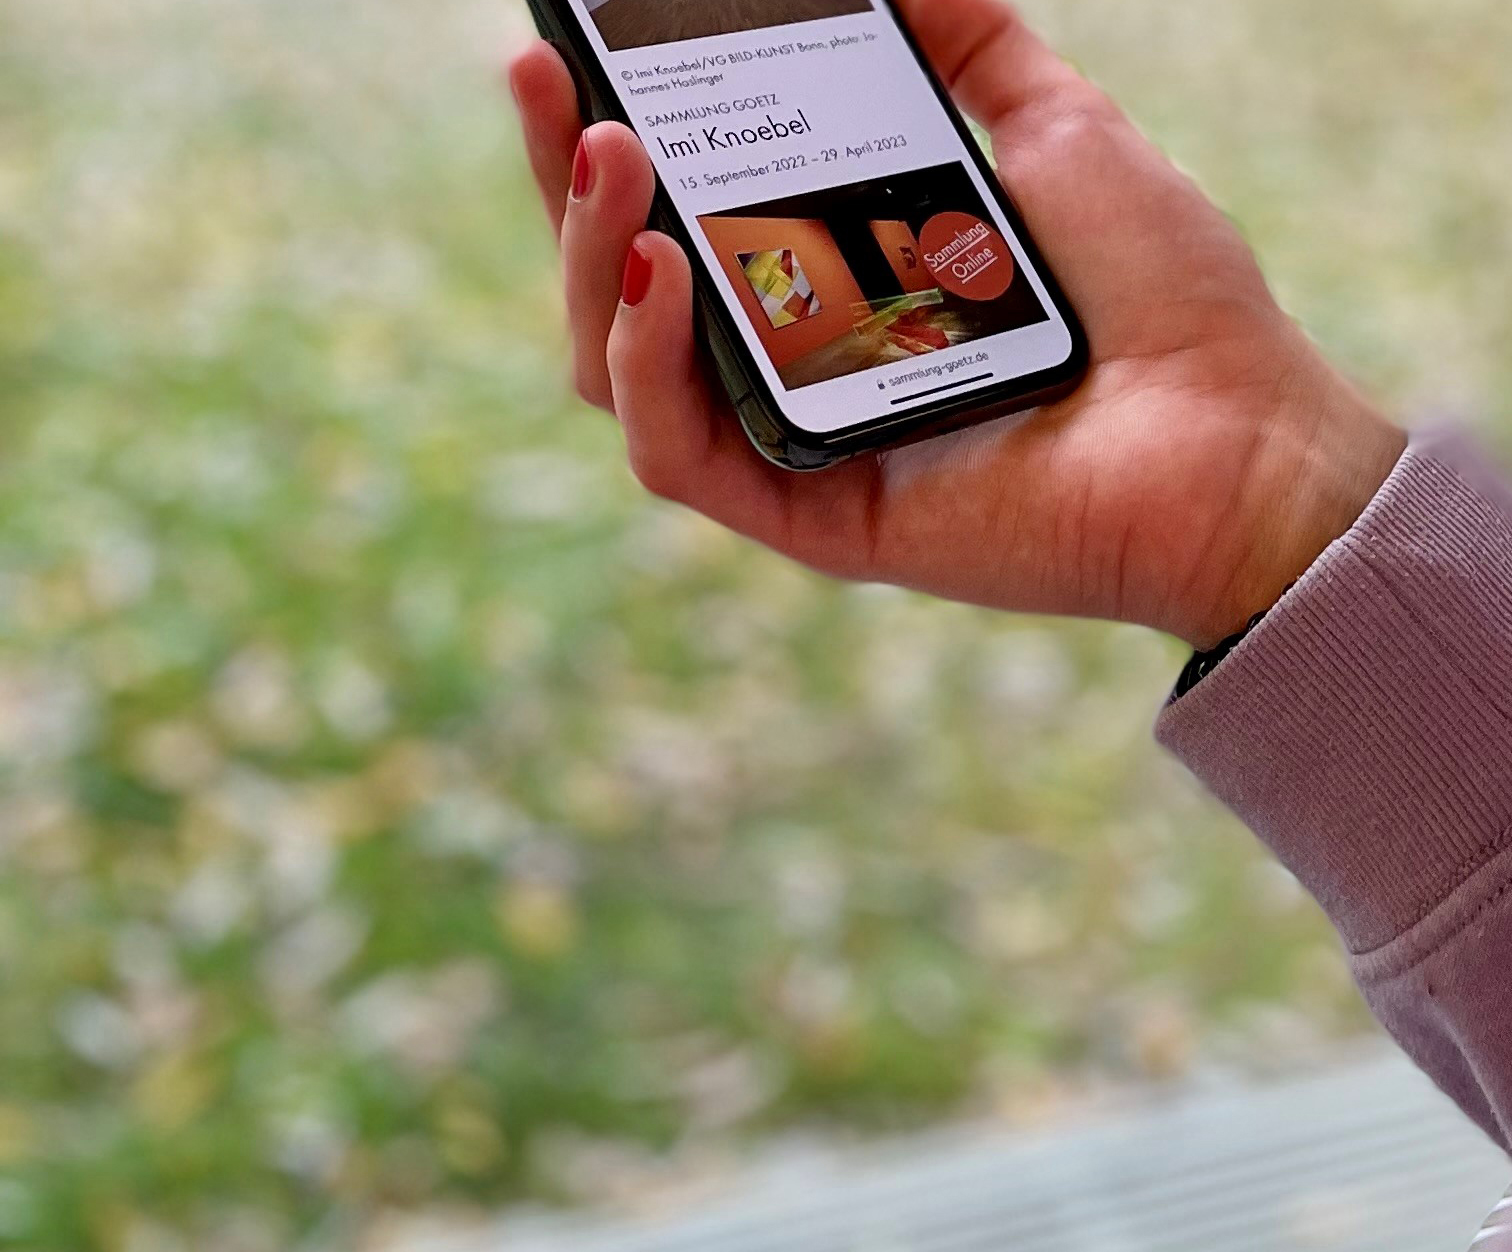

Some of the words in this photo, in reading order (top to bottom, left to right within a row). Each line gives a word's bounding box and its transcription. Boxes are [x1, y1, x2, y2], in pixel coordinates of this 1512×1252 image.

[628, 83, 670, 96] hannes
[635, 66, 652, 79] Imi
[645, 102, 731, 128] SAMMLUNG
[732, 93, 781, 111] GOETZ
[657, 134, 700, 160] Imi
[703, 109, 812, 151] Knoebel
[703, 164, 770, 187] September
[771, 154, 807, 173] 2022
[845, 141, 874, 159] April
[875, 134, 908, 152] 2023
[923, 222, 990, 269] Sammlung
[951, 246, 994, 281] Online
[888, 352, 989, 386] sammlung-goetz.de
